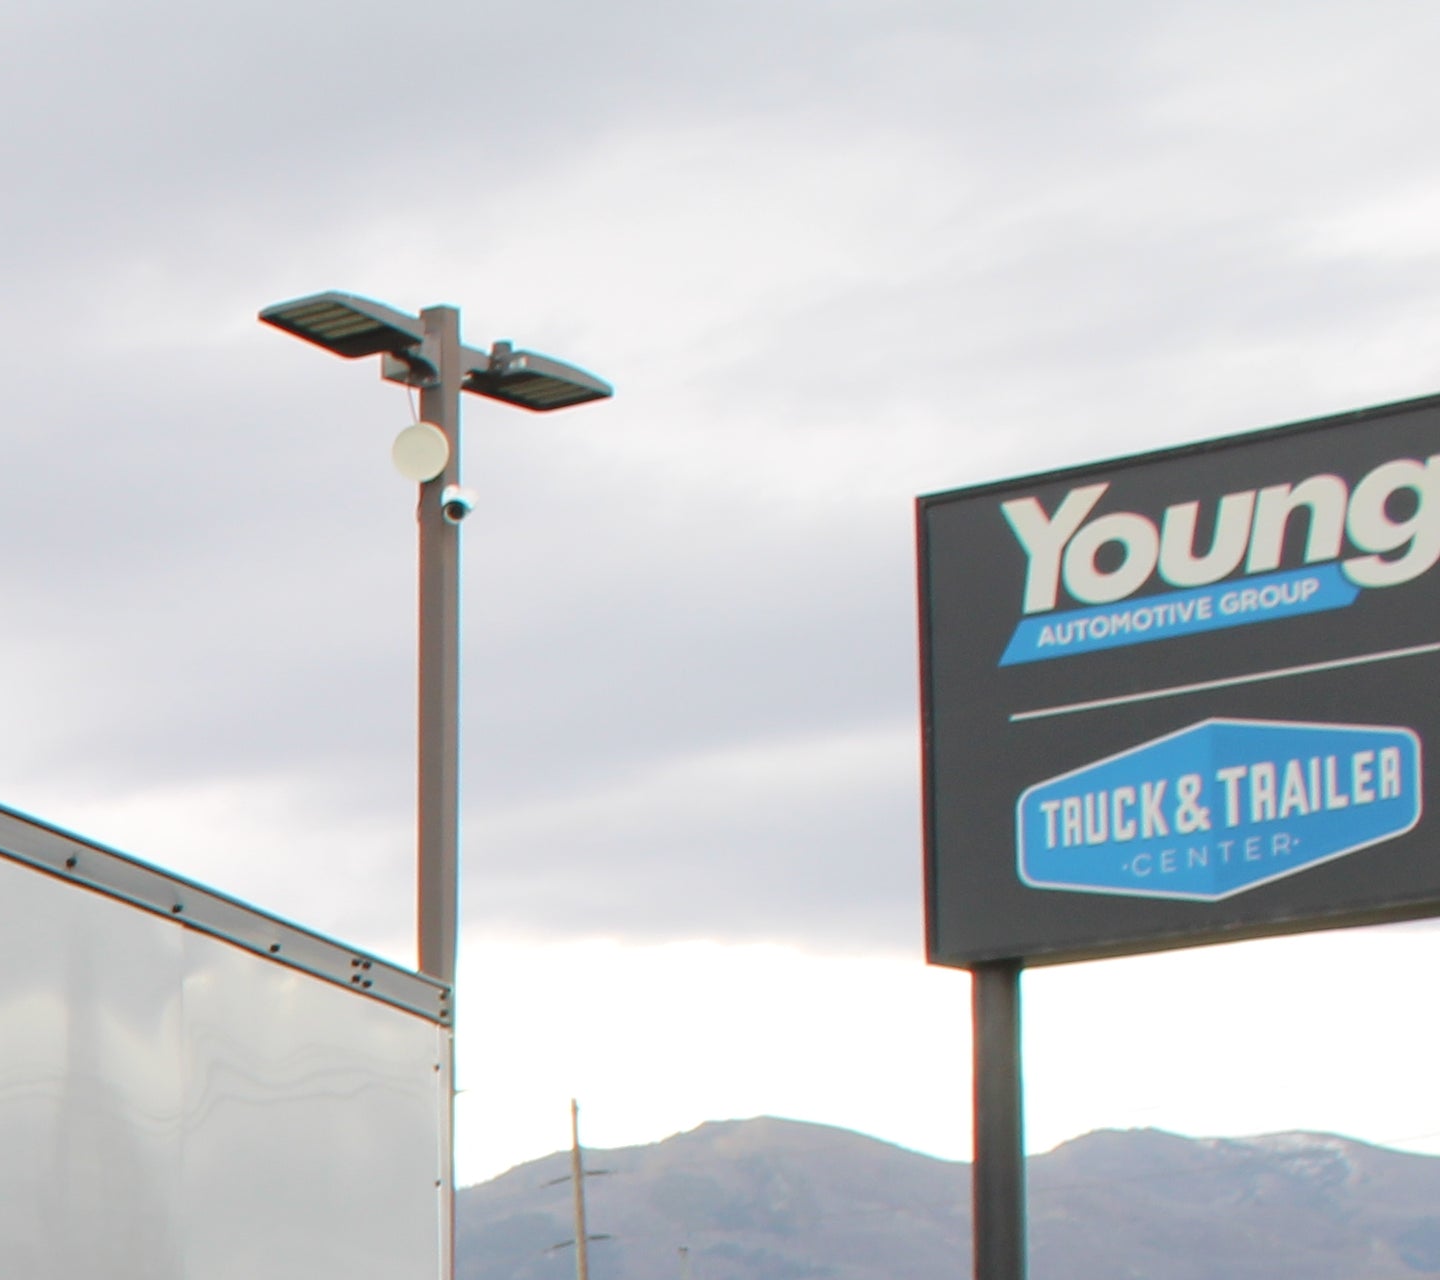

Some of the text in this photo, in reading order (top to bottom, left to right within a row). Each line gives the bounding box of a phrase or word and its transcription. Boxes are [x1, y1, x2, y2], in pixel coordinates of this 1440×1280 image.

[1000, 453, 1440, 615] Young
[1037, 577, 1320, 648] AUTOMOTIVE GROUP
[1040, 746, 1401, 849] TRUCK & TRAILER
[1131, 832, 1293, 878] CENTER
